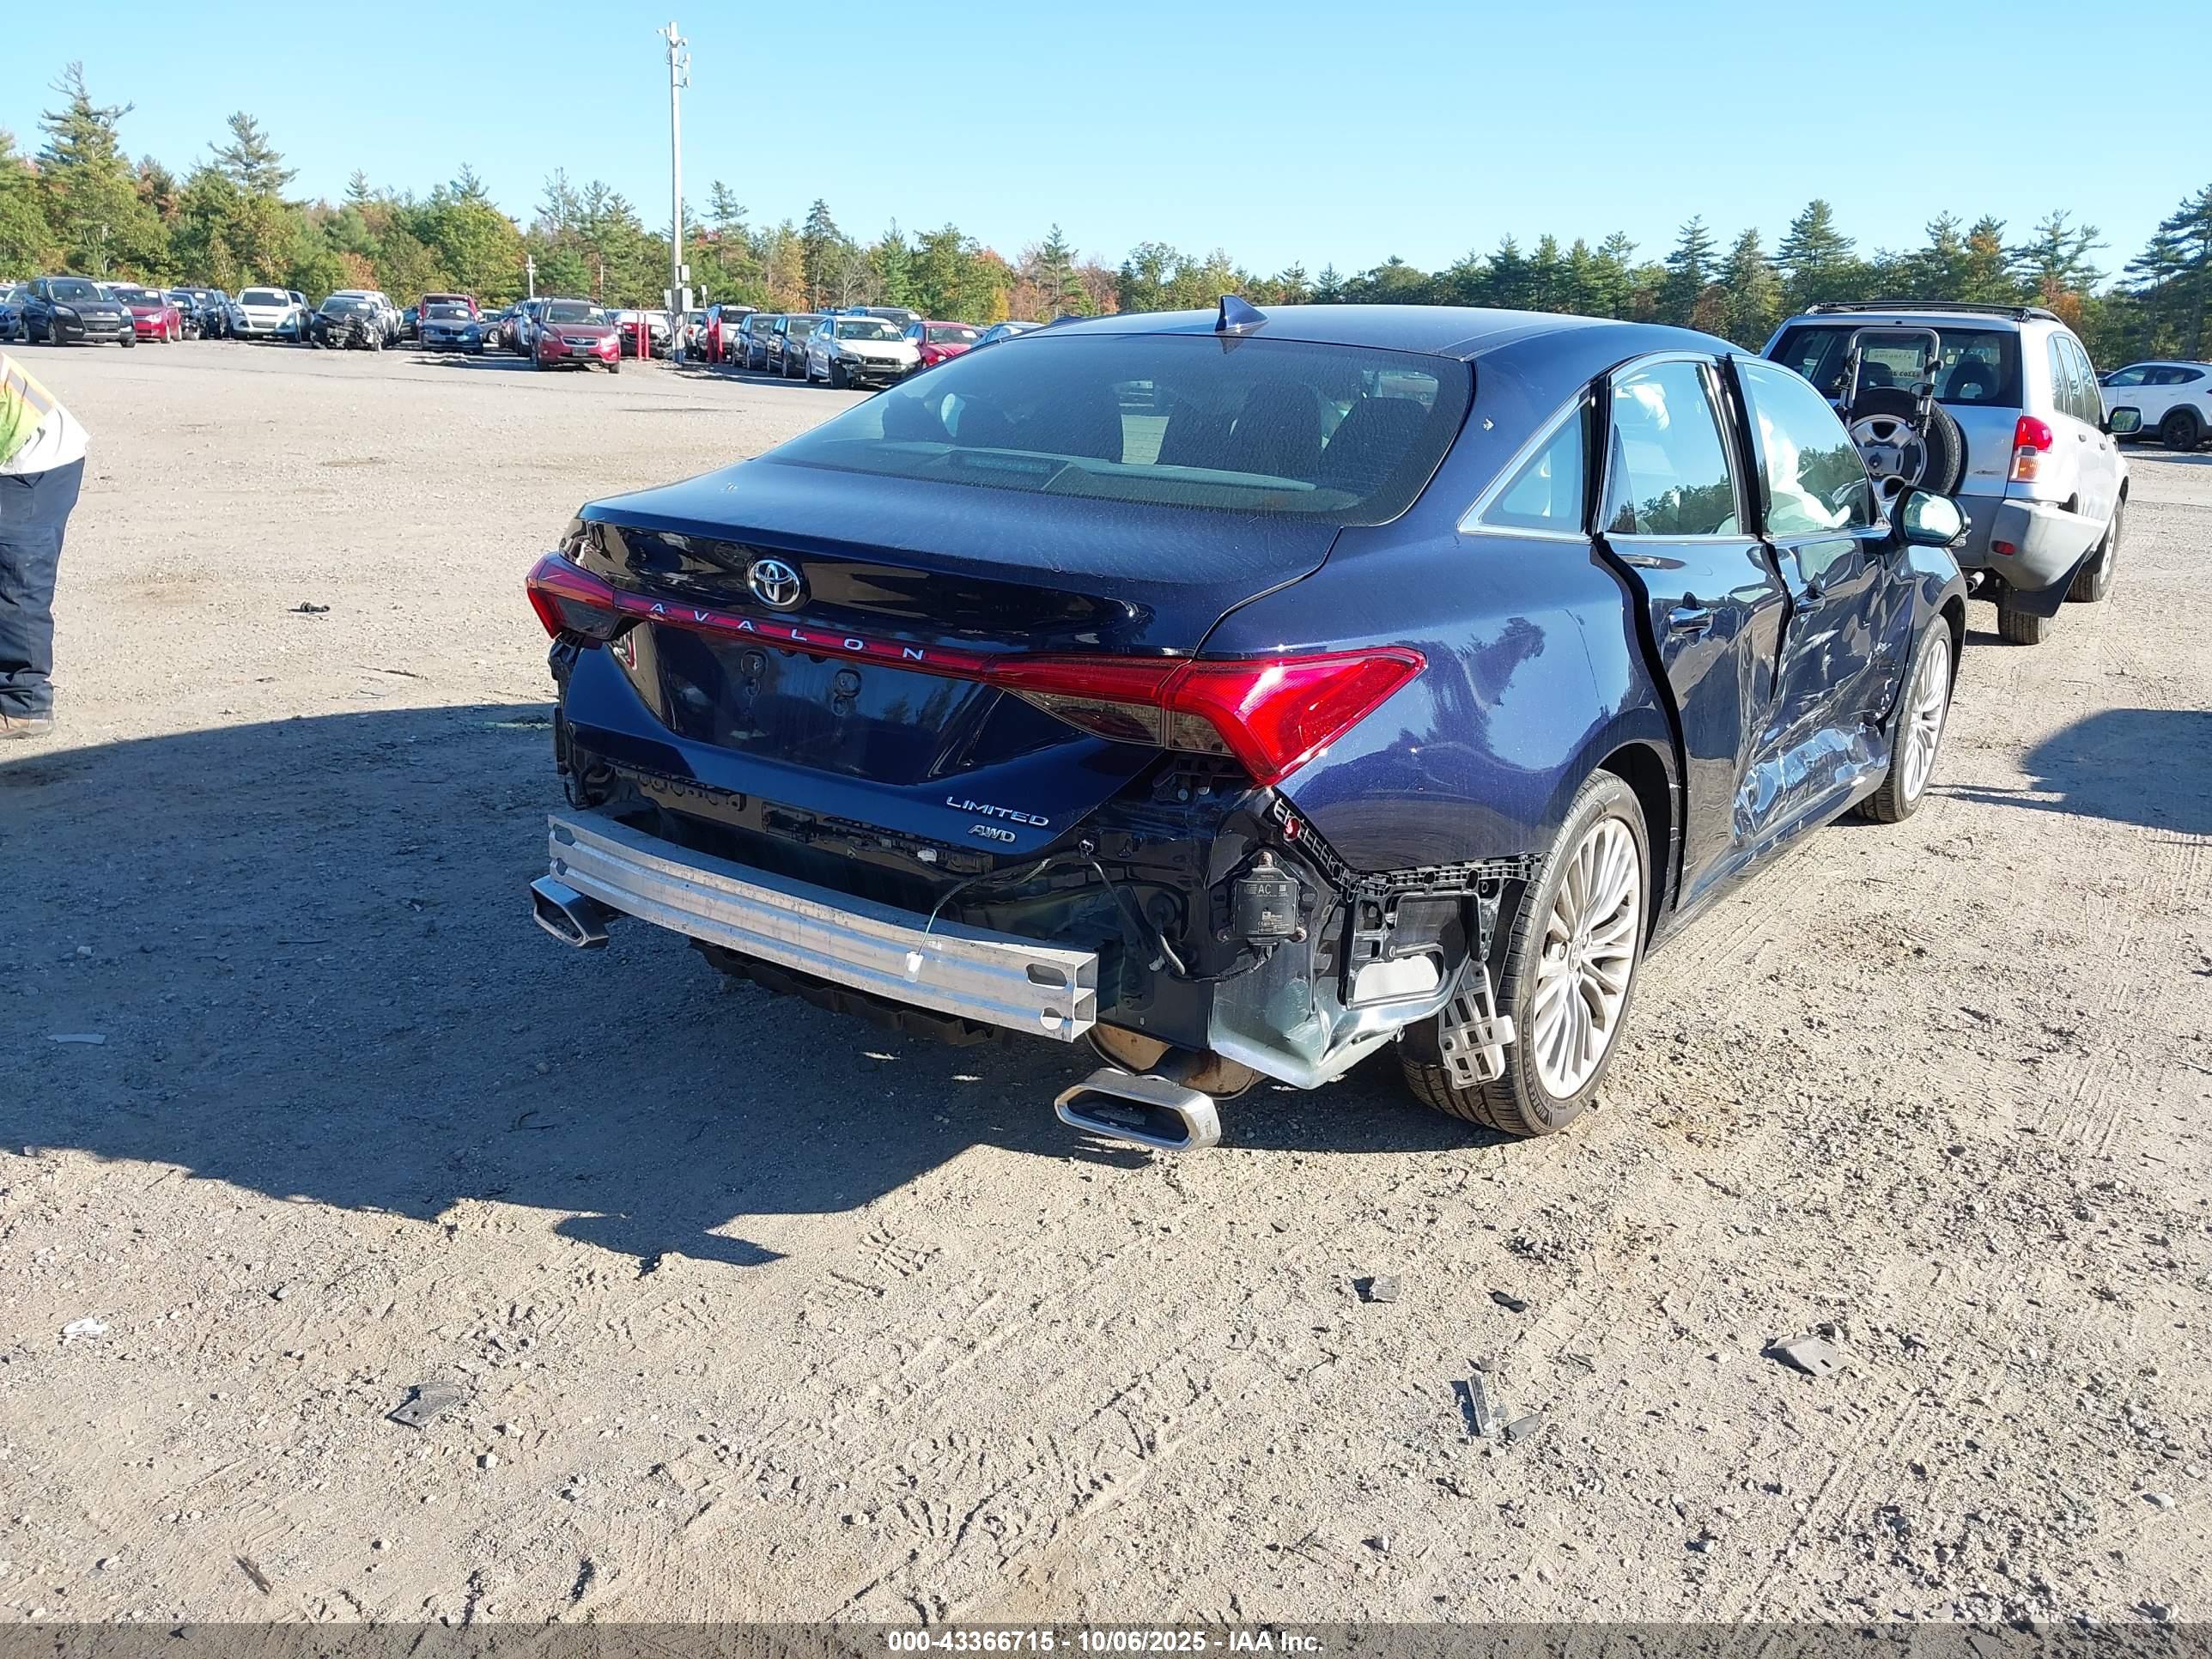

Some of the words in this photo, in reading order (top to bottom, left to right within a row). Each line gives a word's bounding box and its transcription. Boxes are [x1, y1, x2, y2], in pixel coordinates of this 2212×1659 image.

[649, 602, 924, 660] AVALON
[946, 796, 1049, 826] LIMITED
[967, 824, 1016, 842] AWD
[1258, 884, 1271, 894] AC
